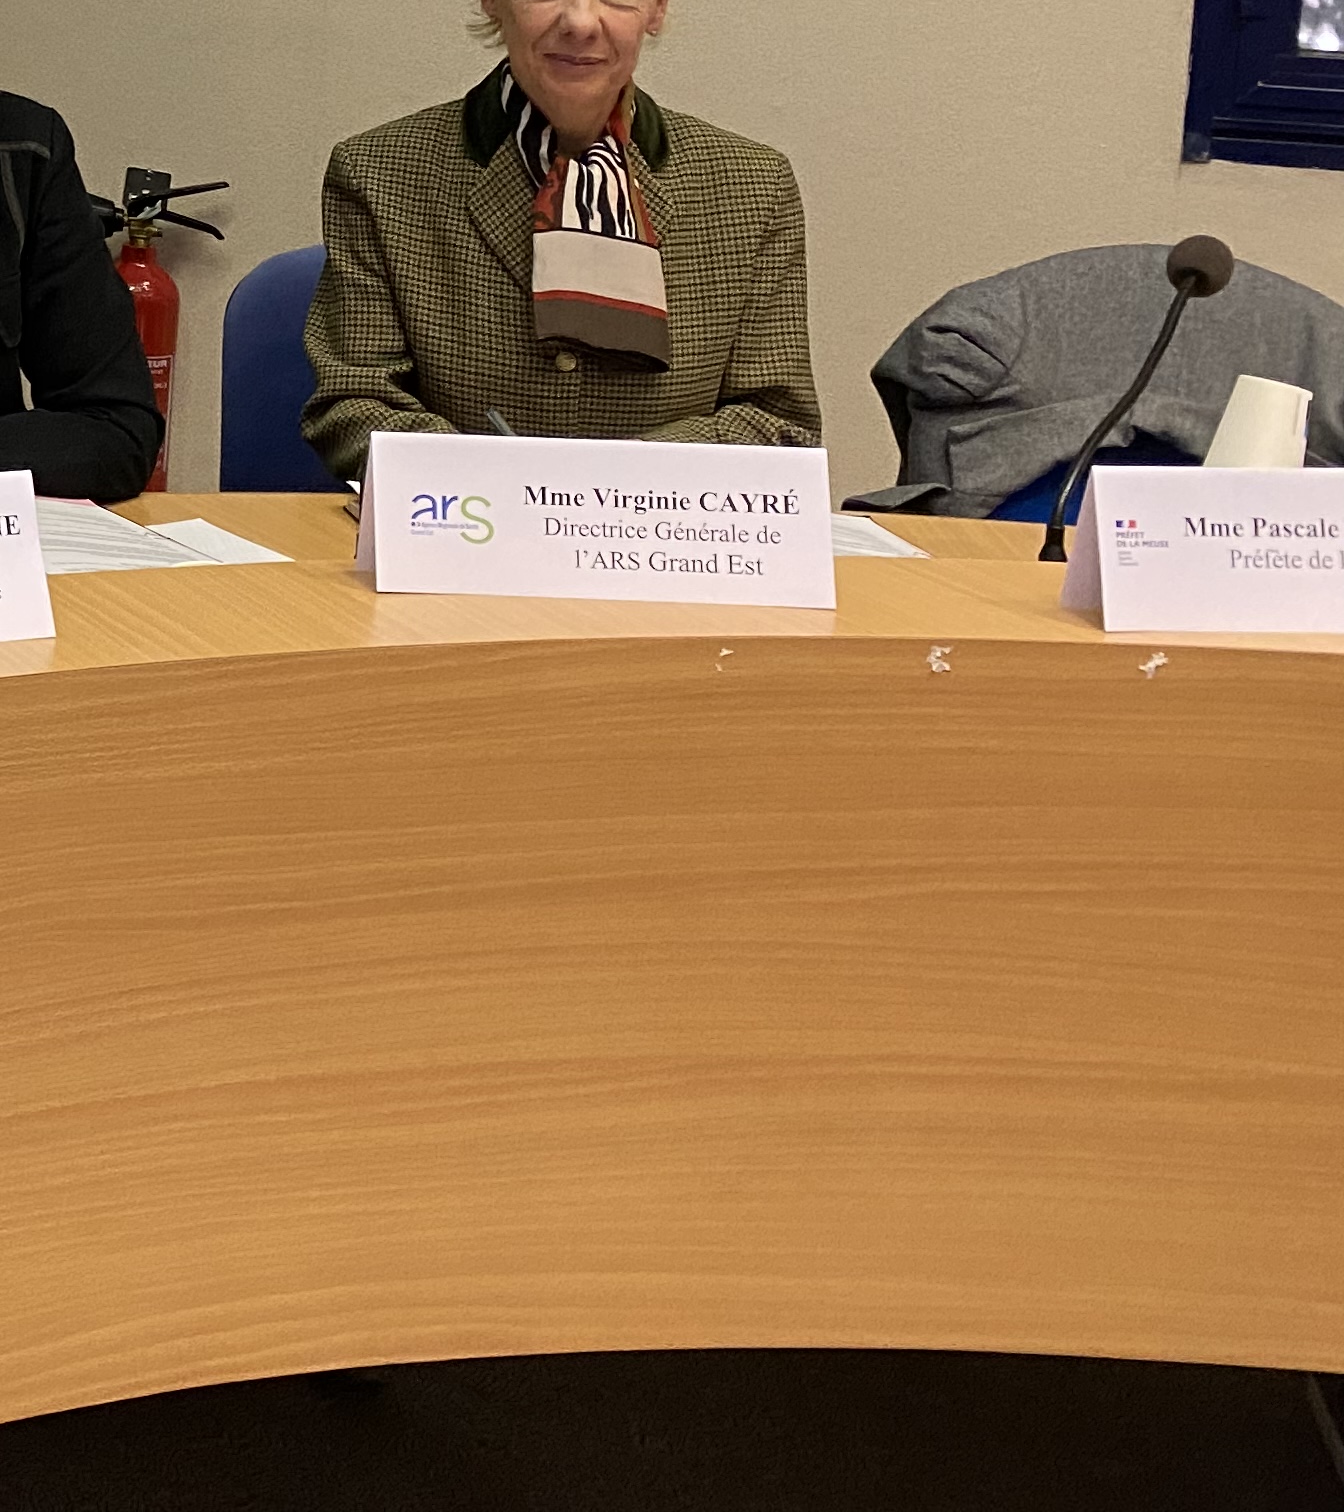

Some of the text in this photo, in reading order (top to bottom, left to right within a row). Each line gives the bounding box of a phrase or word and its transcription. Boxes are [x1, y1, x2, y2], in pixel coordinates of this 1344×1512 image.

[523, 485, 800, 515] Mme Virginie CAYRÉ
[543, 517, 782, 544] Directrice Générale de
[1184, 517, 1340, 538] Mme Pascale
[648, 551, 719, 574] Grand
[727, 554, 764, 576] Est
[1230, 548, 1303, 569] Préfète
[1309, 548, 1333, 569] de
